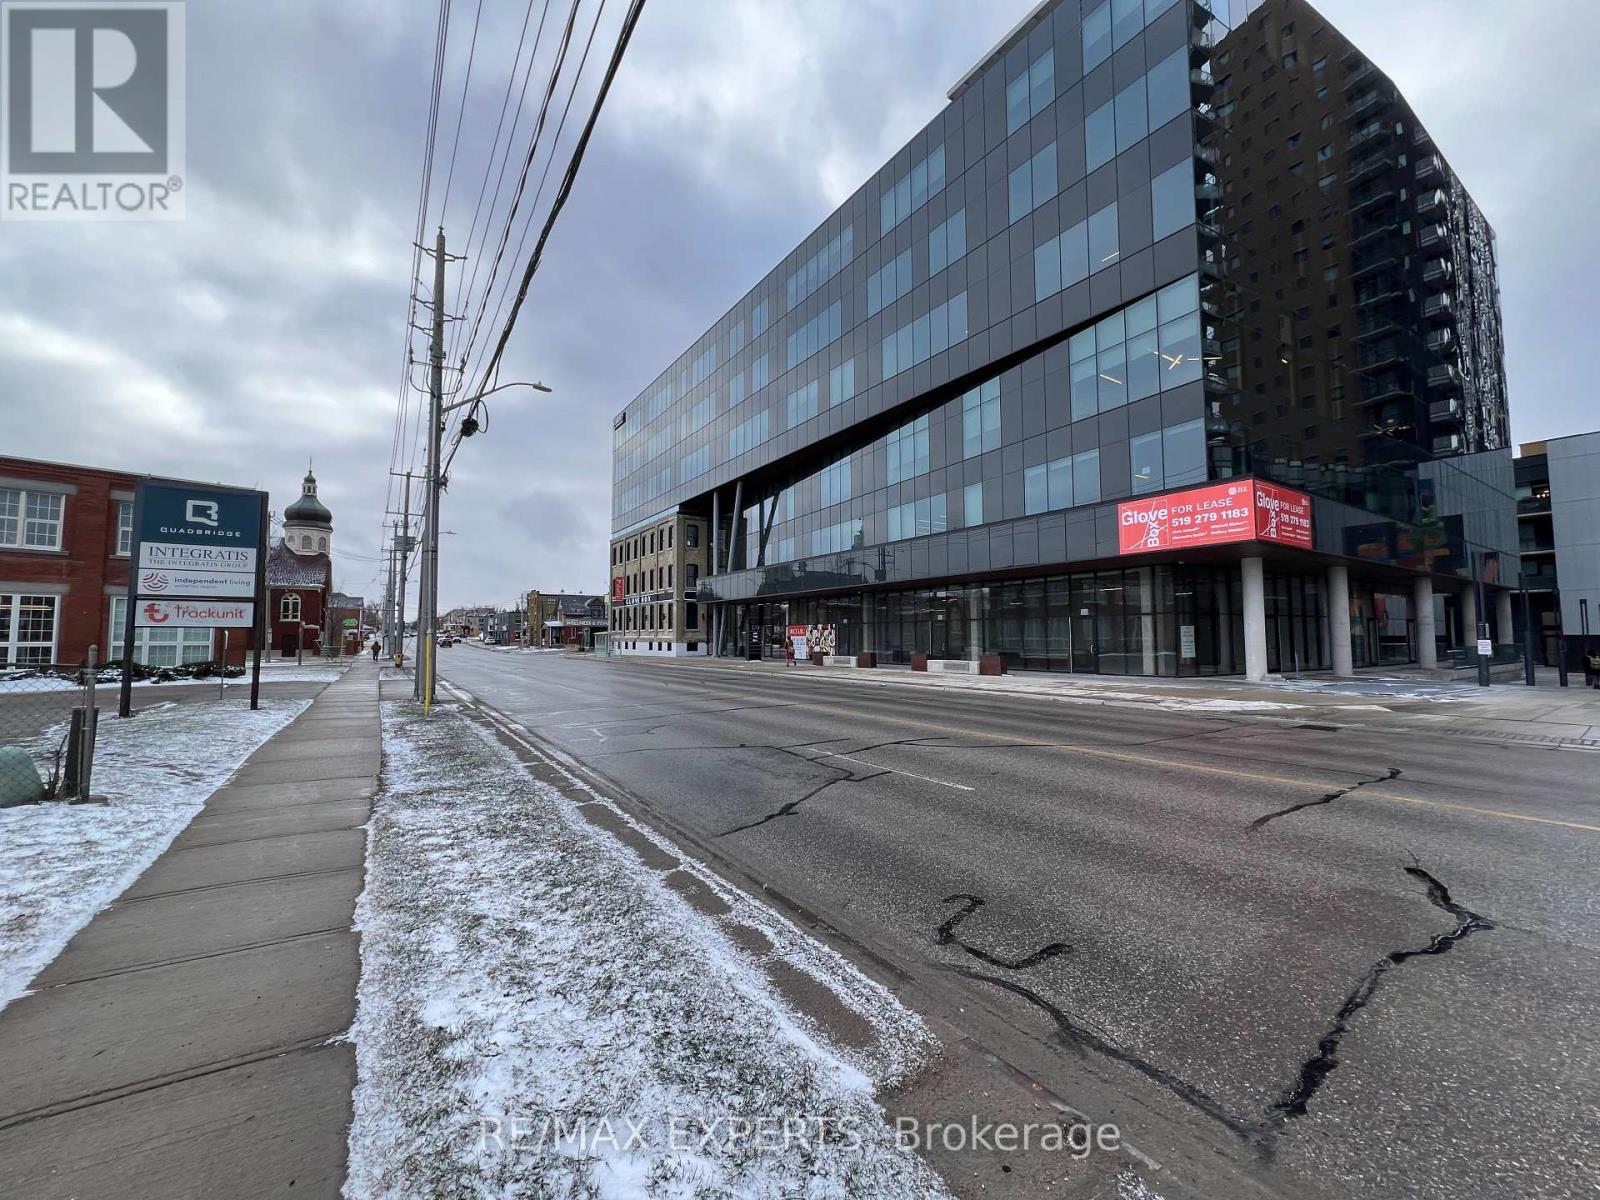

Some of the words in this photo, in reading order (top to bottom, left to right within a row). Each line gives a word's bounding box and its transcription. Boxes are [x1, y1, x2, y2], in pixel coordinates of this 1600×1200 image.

[1171, 504, 1193, 515] FOR
[1196, 497, 1233, 512] LEASE
[1256, 491, 1280, 512] Glove
[1280, 501, 1290, 511] FOR
[1290, 504, 1304, 515] LEASE
[1121, 507, 1169, 526] Glove
[1171, 516, 1192, 527] 519
[1194, 512, 1218, 525] 279
[1220, 507, 1249, 520] 1183
[160, 526, 241, 537] QUADBRIDGE
[1147, 520, 1160, 547] Box
[149, 546, 249, 561] INTEGRATIS
[168, 560, 218, 568] INTEGRATIS
[174, 576, 227, 587] independent
[229, 579, 251, 587] living
[175, 604, 244, 619] Trackunit
